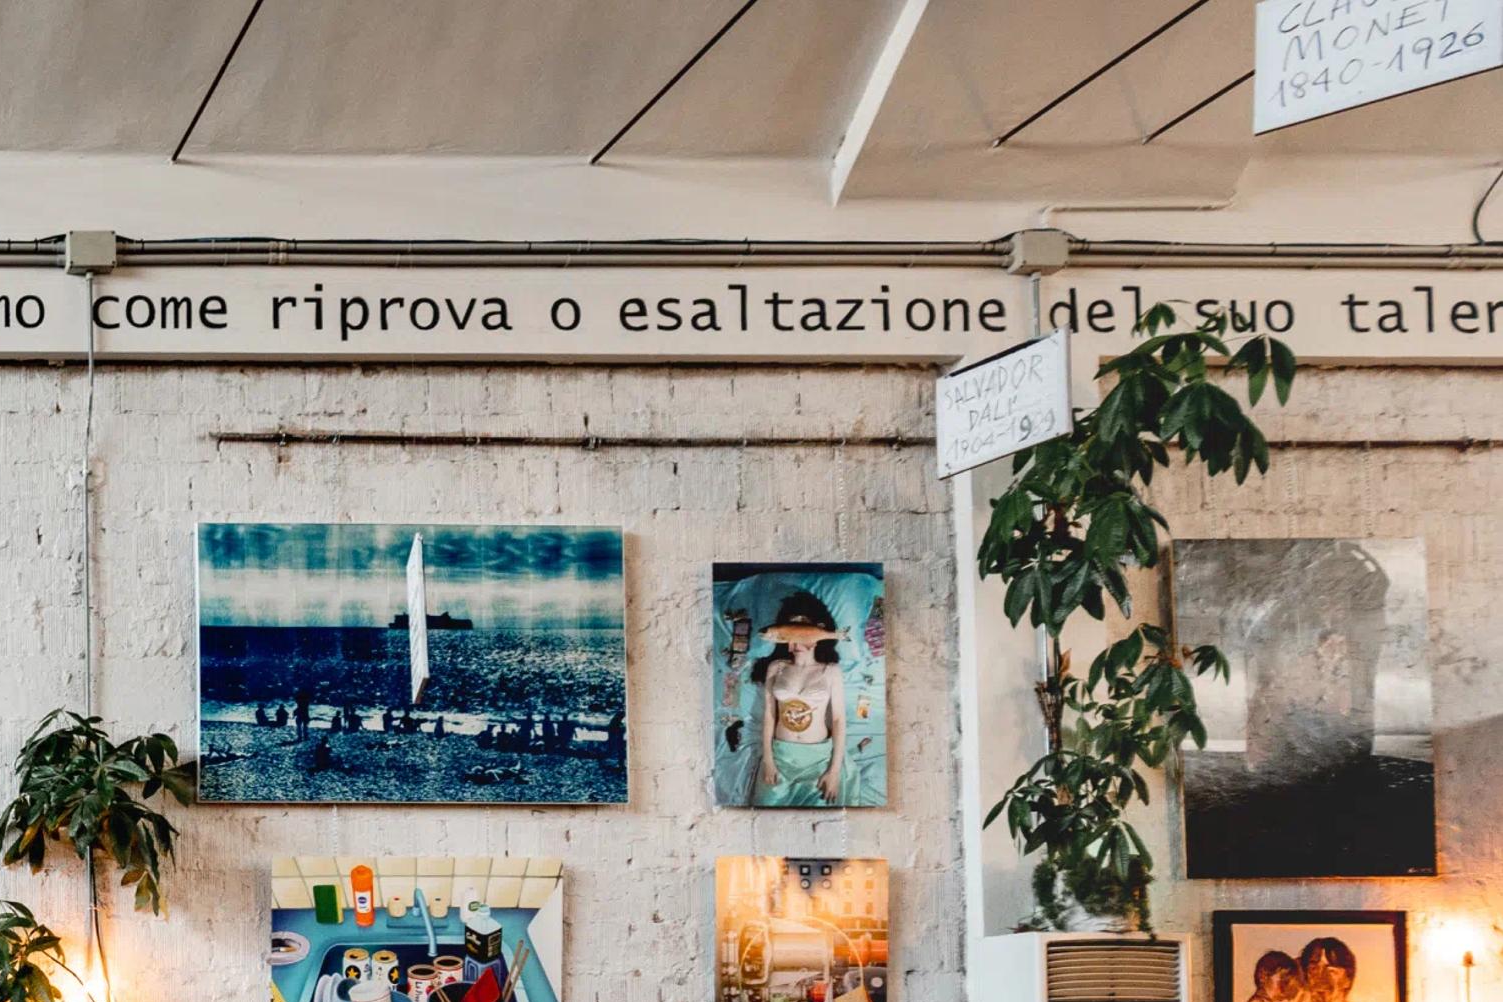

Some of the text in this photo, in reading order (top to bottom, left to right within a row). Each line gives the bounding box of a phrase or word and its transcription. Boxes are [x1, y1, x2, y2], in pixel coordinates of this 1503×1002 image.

[1268, 20, 1485, 107] 1840-1926
[1282, 0, 1449, 72] MONET
[91, 294, 228, 330] come
[272, 283, 513, 341] riprova
[550, 297, 581, 331] o
[619, 285, 1007, 332] esaltazione
[1049, 286, 1142, 333] del
[1195, 298, 1295, 333] suo
[944, 354, 1043, 412] SALVADOR
